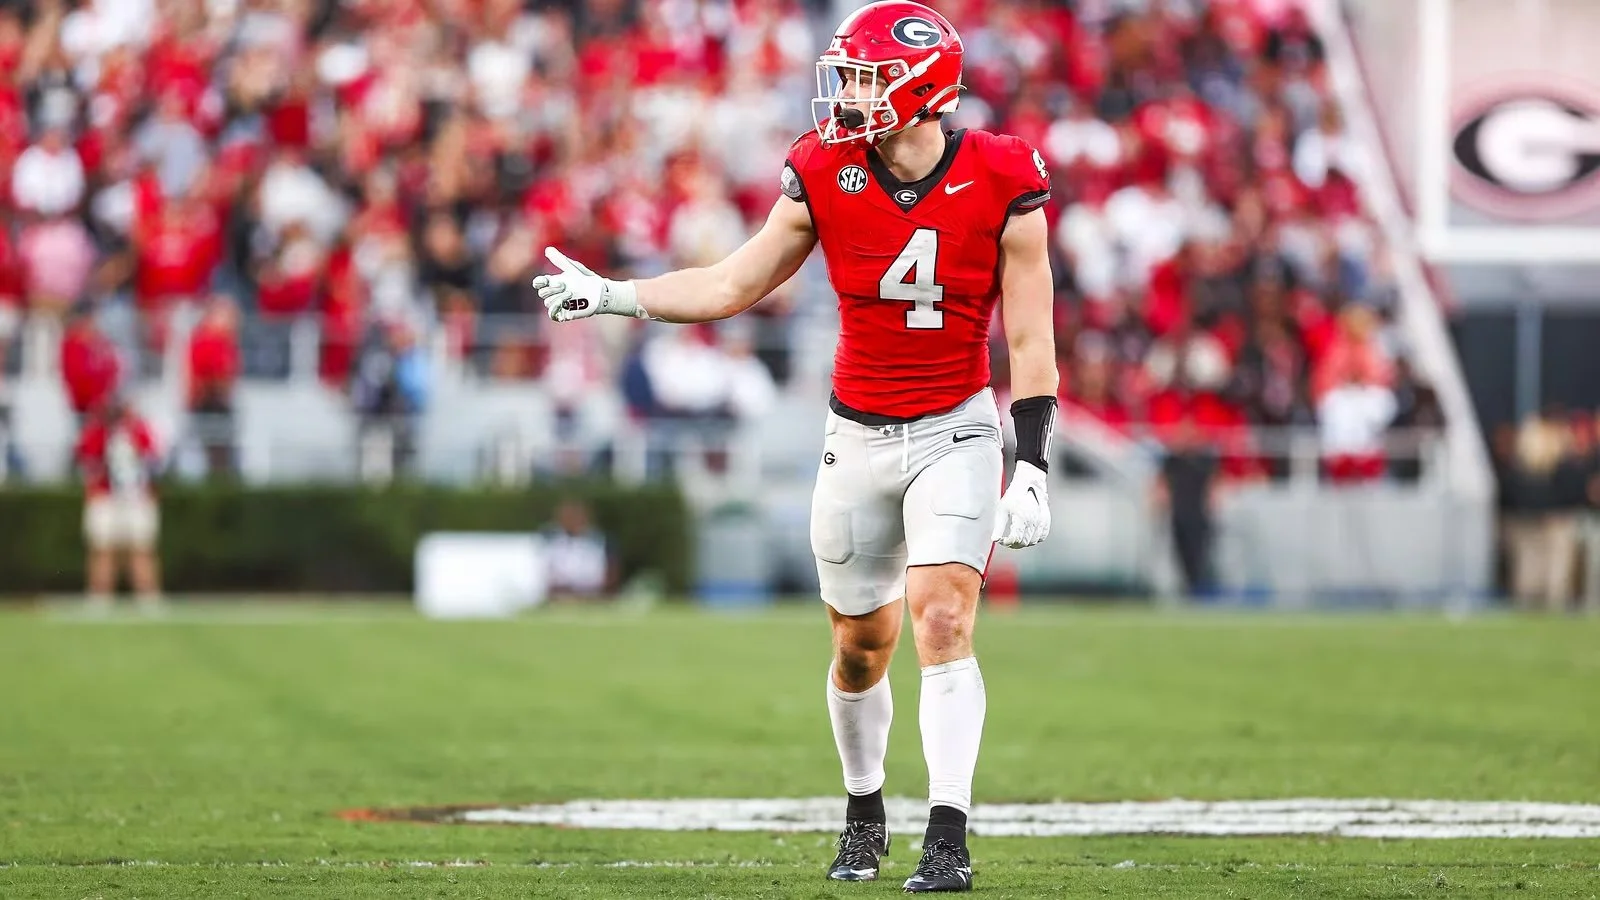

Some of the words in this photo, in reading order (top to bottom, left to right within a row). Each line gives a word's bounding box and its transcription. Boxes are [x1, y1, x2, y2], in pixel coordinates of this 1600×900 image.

[893, 18, 940, 46] G
[1453, 94, 1600, 195] G
[1032, 149, 1048, 179] 4
[839, 167, 866, 191] SEC
[896, 191, 917, 203] G
[879, 227, 944, 329] 4
[824, 452, 836, 465] G
